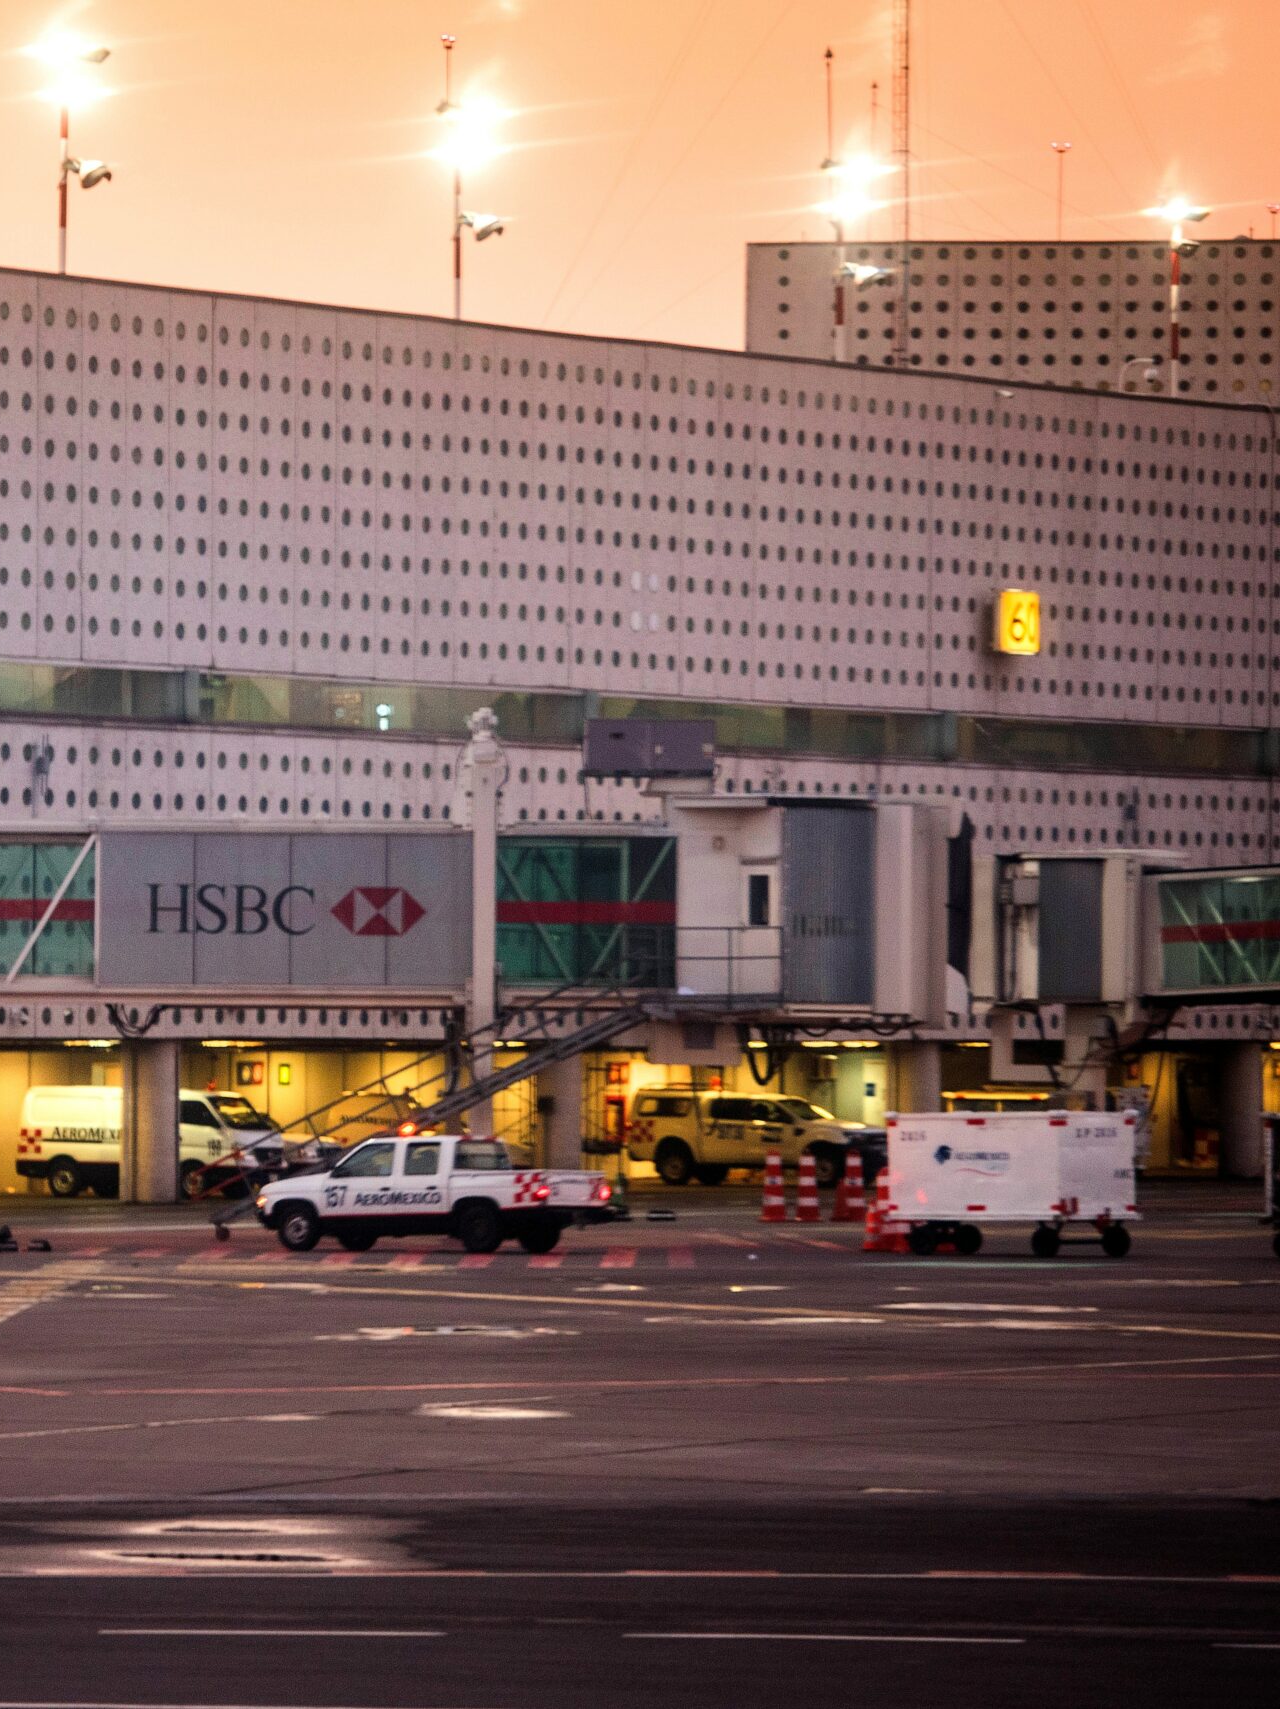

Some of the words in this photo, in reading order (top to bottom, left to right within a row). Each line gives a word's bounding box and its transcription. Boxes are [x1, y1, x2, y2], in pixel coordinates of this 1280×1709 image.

[1008, 602, 1040, 642] 60
[145, 882, 316, 936] HSBC
[324, 1185, 348, 1208] 157
